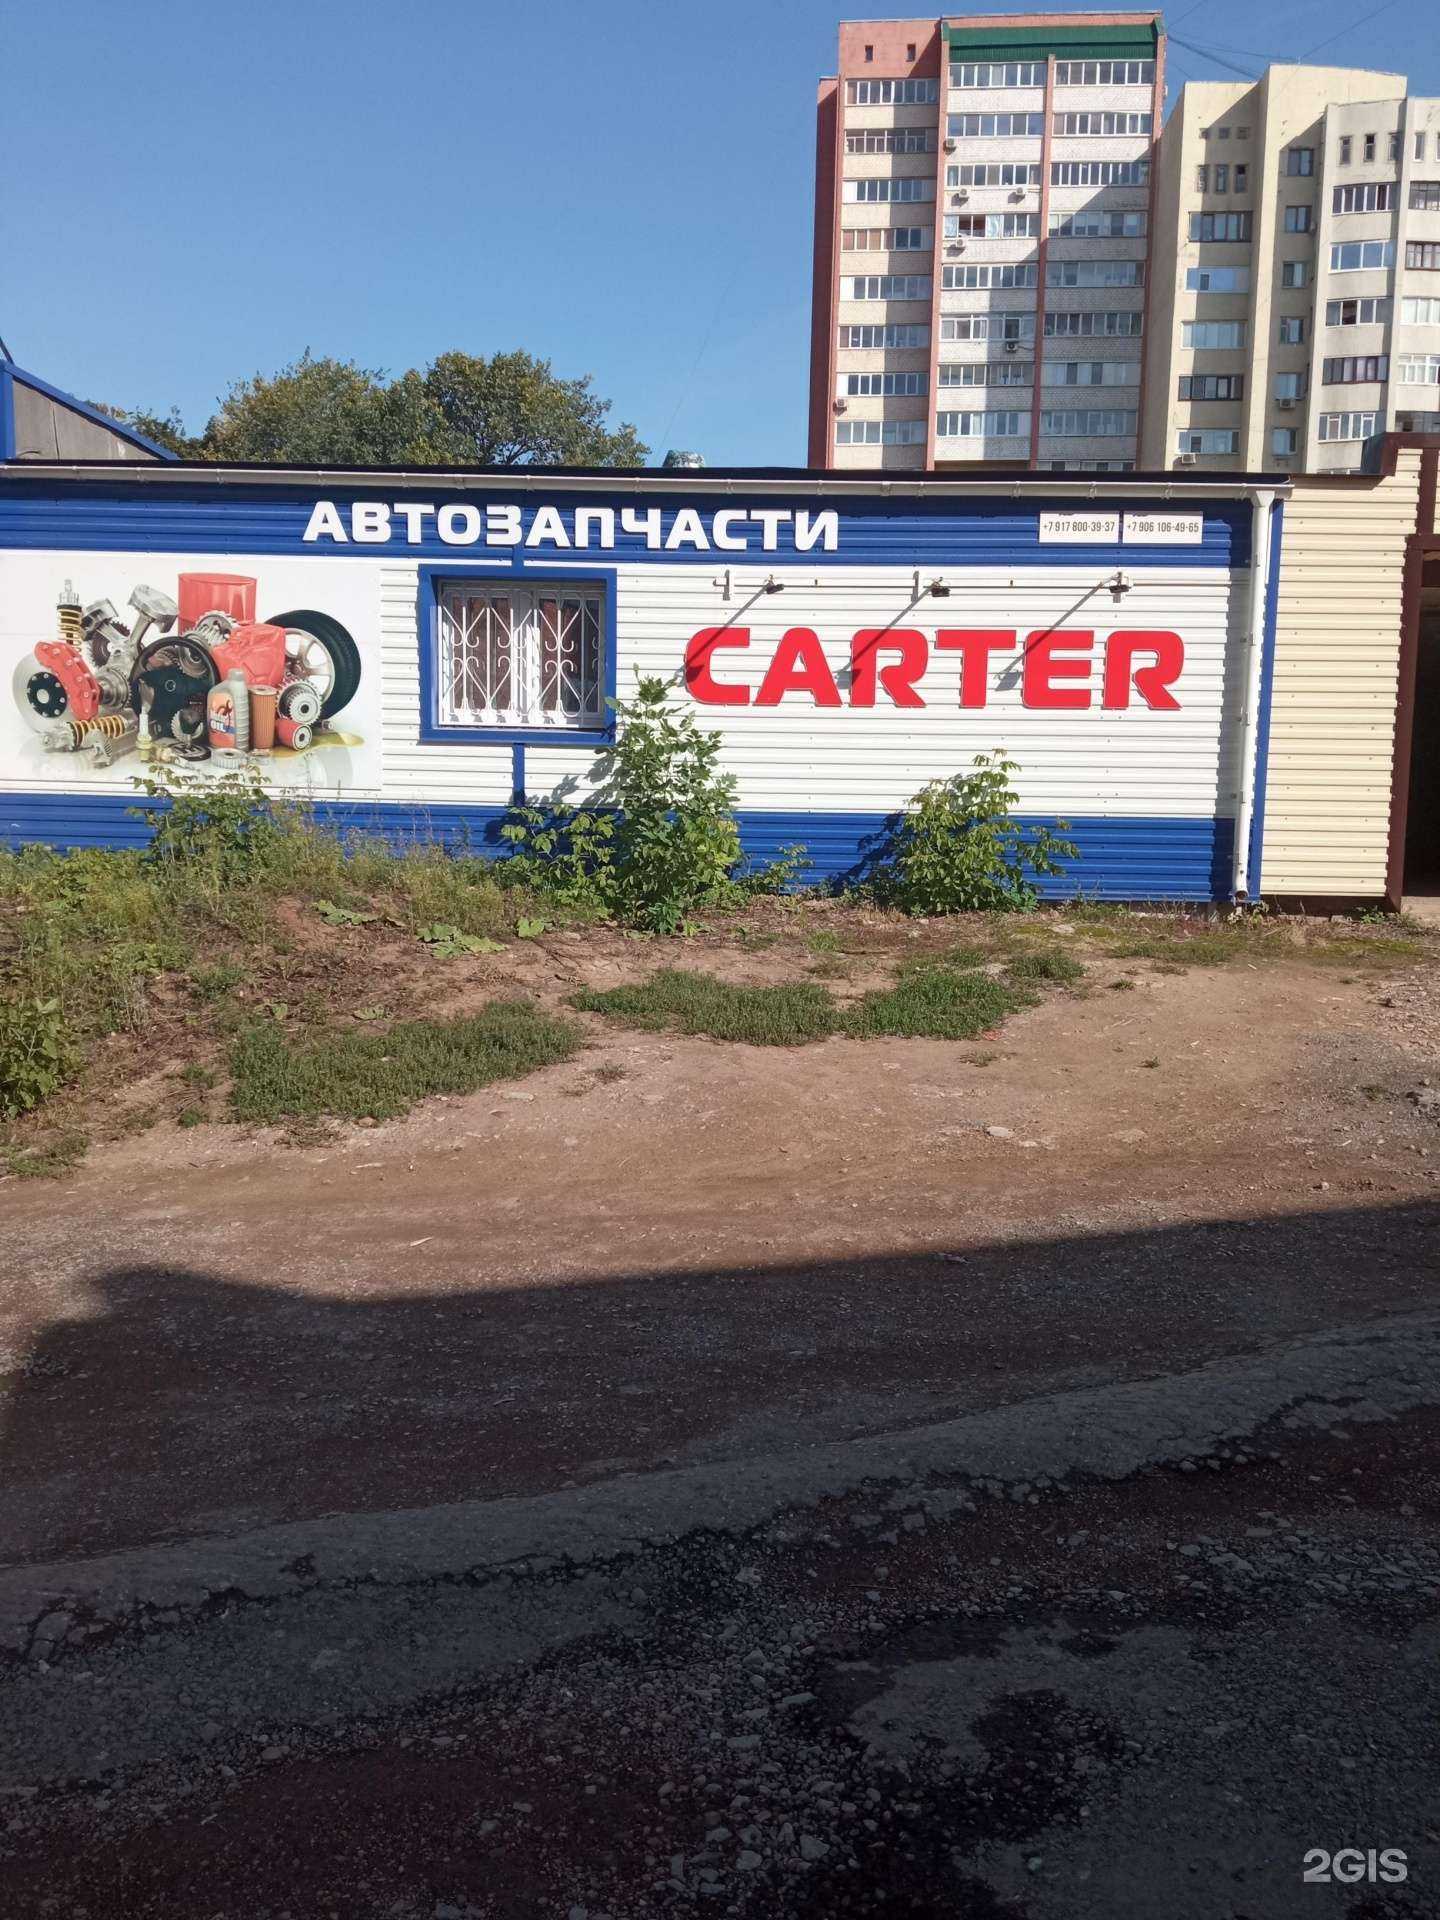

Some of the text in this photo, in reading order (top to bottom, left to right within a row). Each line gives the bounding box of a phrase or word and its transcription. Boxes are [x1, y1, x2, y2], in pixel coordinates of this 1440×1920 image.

[302, 500, 839, 551] АВТОЗАПЧАСТИ
[684, 627, 1185, 710] CARTER
[210, 719, 226, 733] OIL
